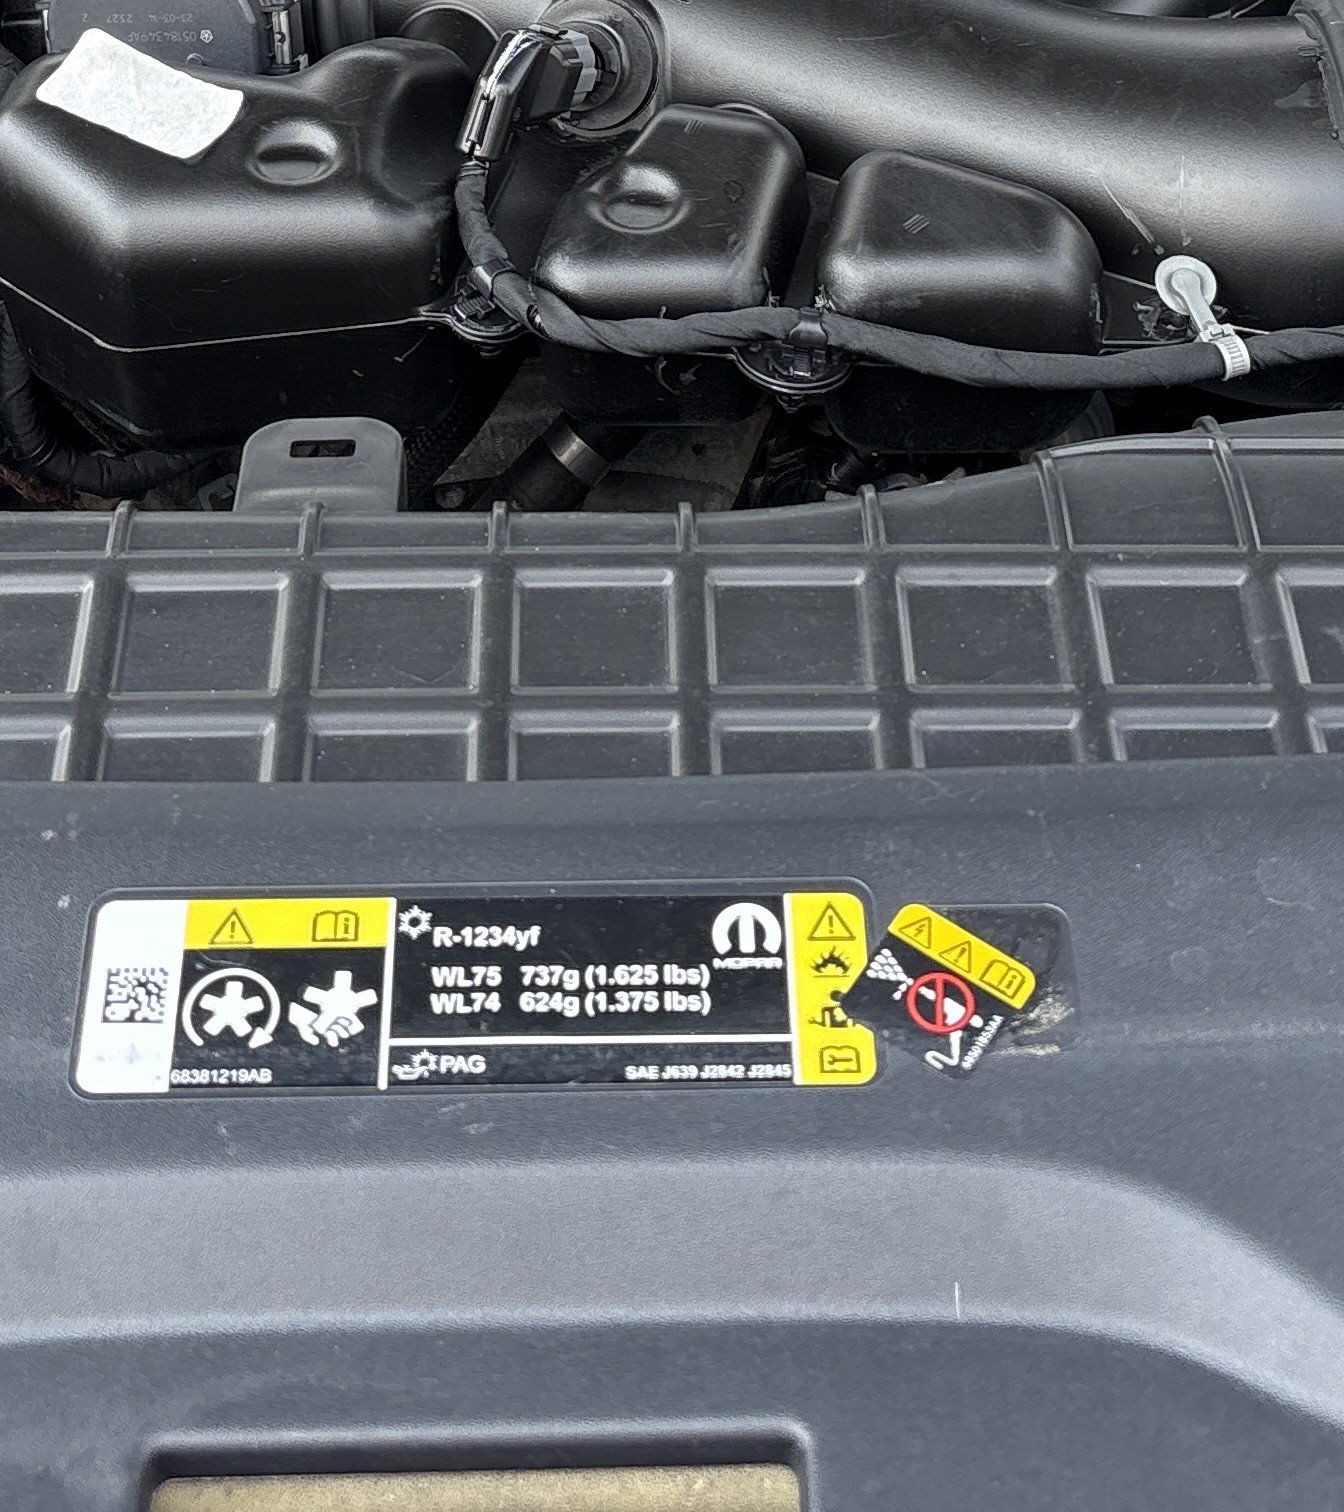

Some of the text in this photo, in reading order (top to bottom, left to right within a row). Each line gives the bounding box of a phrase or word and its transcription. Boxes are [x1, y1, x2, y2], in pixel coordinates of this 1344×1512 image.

[431, 925, 542, 952] R-1234yf
[430, 963, 710, 991] WL75 737g (1.625 lbs)
[430, 991, 712, 1017] WL74 624g (1.375 lbs)
[439, 1054, 486, 1074] PAG
[624, 1063, 793, 1080] SAE J639 J2842 J2845
[170, 1068, 273, 1084] 68381219AB
